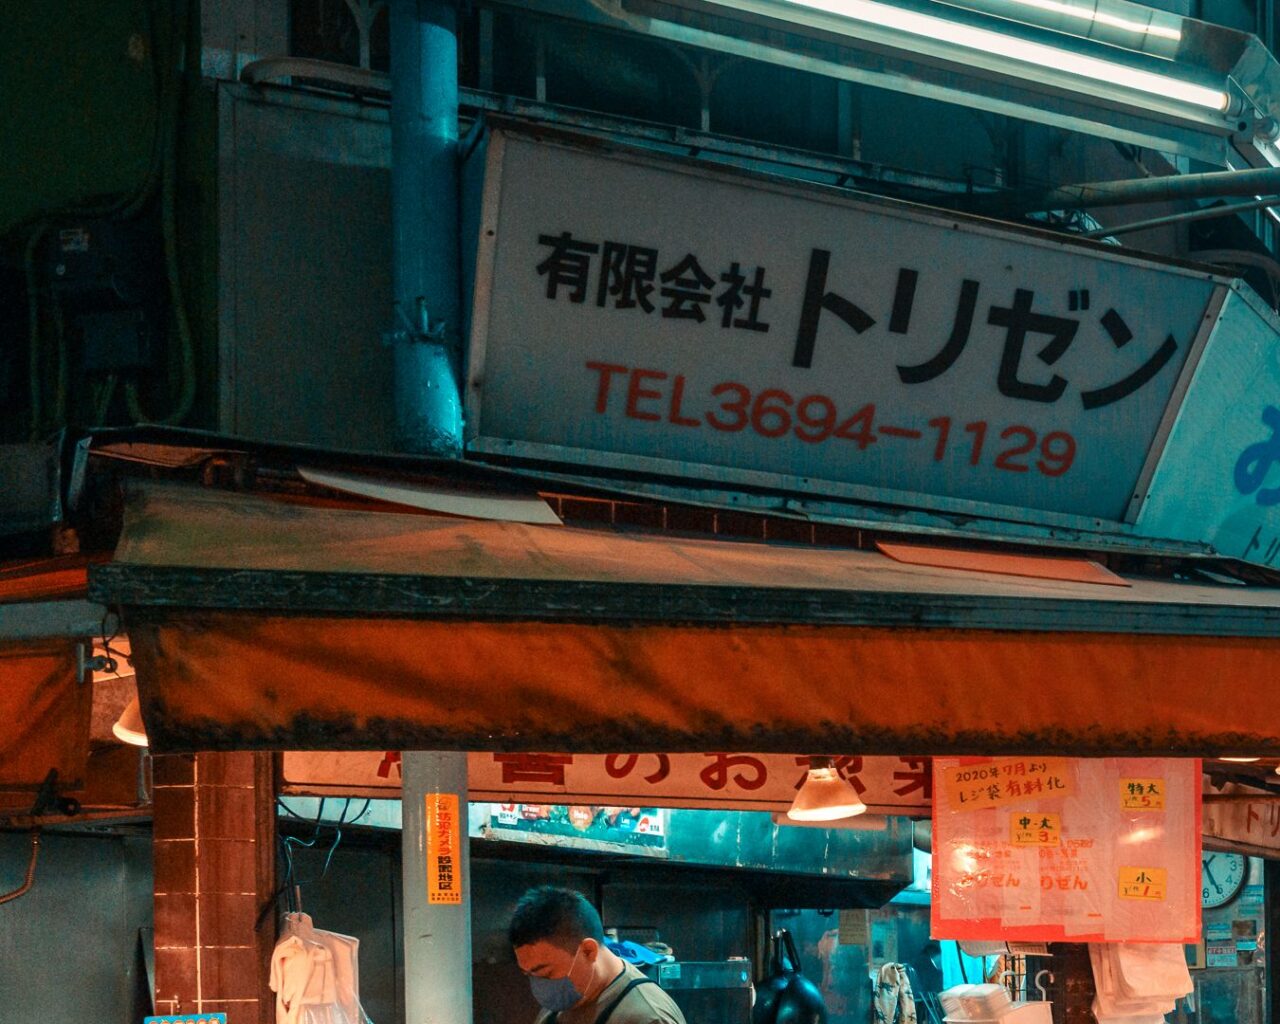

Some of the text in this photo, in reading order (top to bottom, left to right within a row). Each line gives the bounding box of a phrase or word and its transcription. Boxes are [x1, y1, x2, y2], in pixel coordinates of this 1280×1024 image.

[537, 231, 1179, 411] 有限会社トリゼン
[960, 776, 1065, 803] レジ袋有料化
